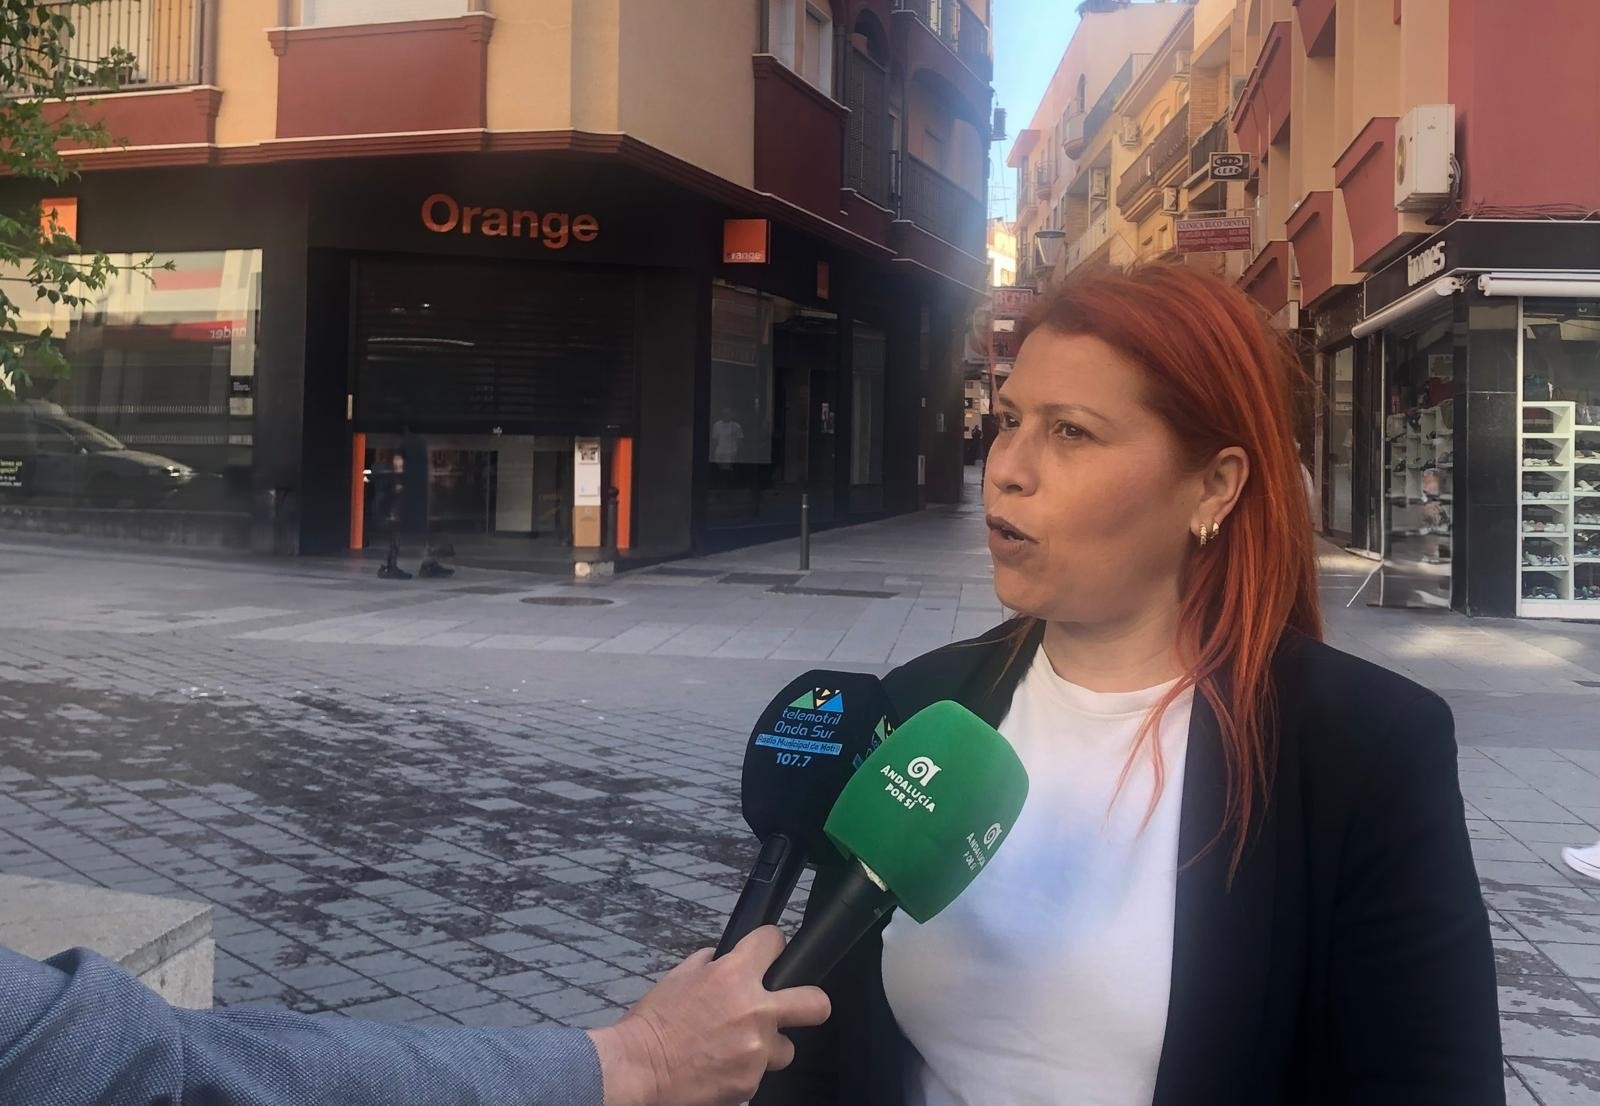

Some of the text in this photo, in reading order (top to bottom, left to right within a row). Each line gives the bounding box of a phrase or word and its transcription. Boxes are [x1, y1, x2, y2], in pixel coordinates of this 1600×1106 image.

[421, 193, 600, 249] Orange
[782, 708, 842, 725] telemotril
[774, 721, 836, 740] Onda Sur
[777, 738, 810, 751] Municipal
[810, 742, 819, 751] de
[776, 752, 812, 768] 107.7
[880, 764, 936, 813] ANDALUCÍA
[885, 782, 918, 810] POR SÍ
